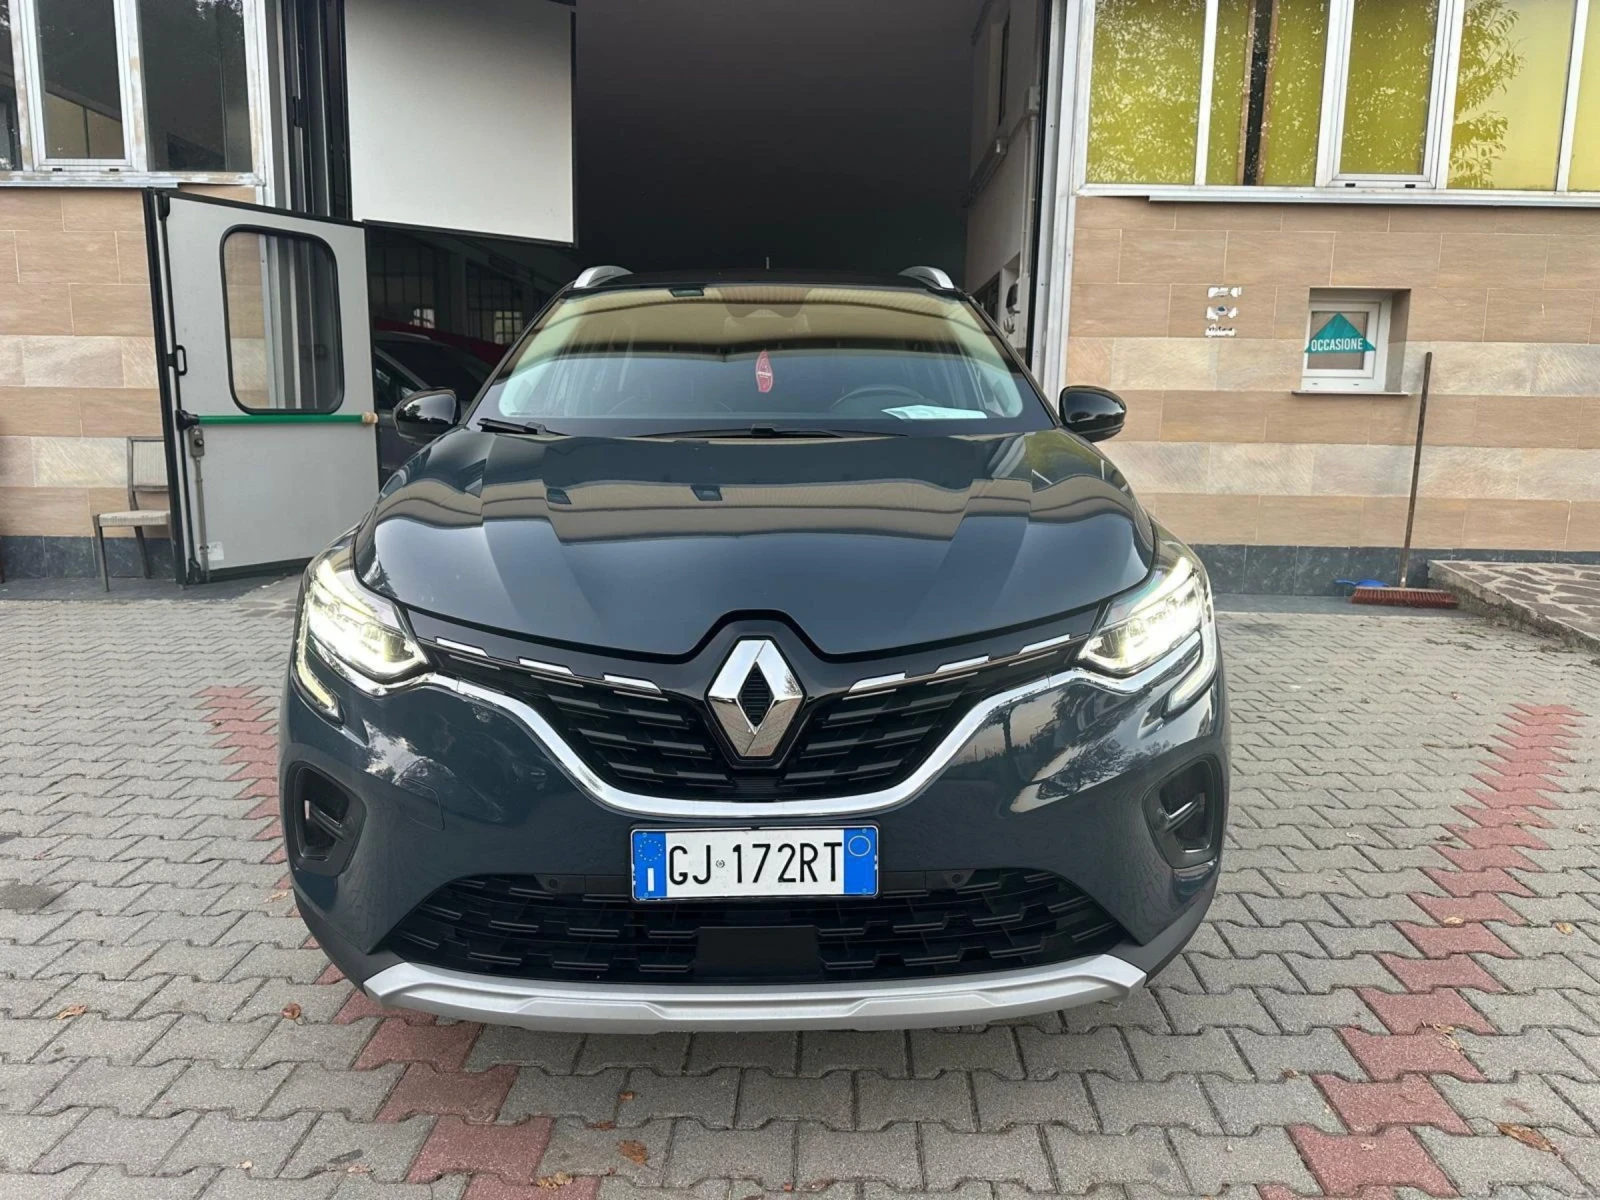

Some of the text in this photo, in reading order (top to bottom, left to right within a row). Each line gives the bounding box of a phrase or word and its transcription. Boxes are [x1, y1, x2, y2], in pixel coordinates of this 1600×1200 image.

[1311, 338, 1363, 351] OCCASIONE
[669, 842, 842, 885] GJ 172RT
[647, 867, 655, 892] I
